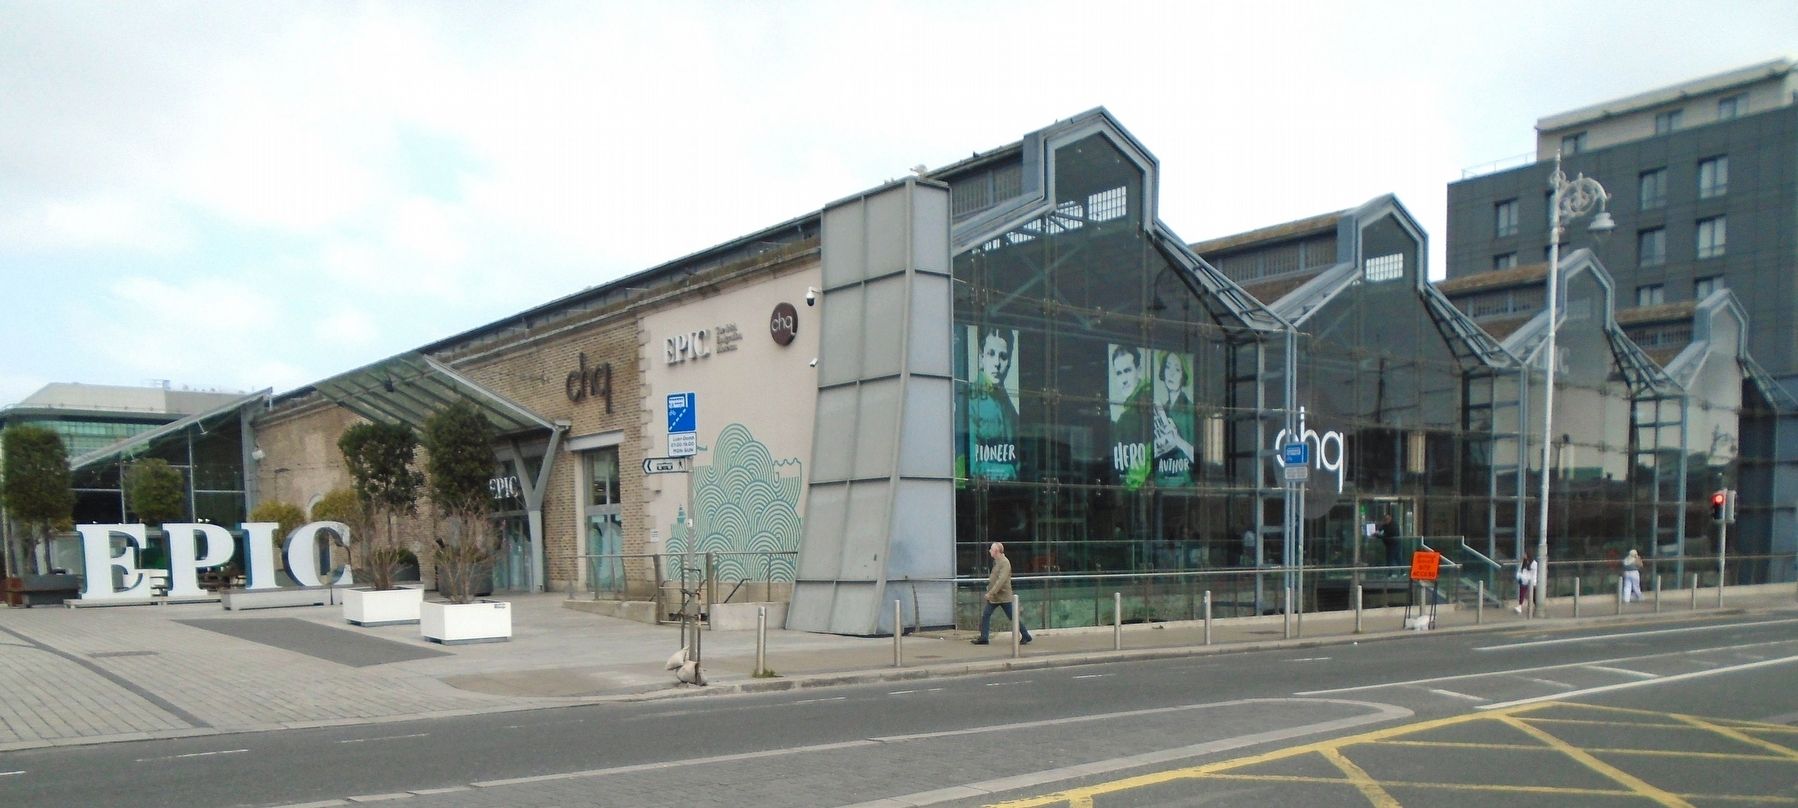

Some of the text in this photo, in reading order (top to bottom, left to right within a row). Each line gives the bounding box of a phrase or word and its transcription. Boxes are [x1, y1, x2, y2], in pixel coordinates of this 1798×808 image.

[771, 312, 796, 335] chq
[664, 329, 711, 366] EPIC
[566, 351, 613, 415] chq
[975, 443, 1016, 462] PIONEER
[1113, 442, 1146, 471] HERO
[1158, 458, 1190, 474] AUTHOR
[76, 520, 354, 600] EPIC
